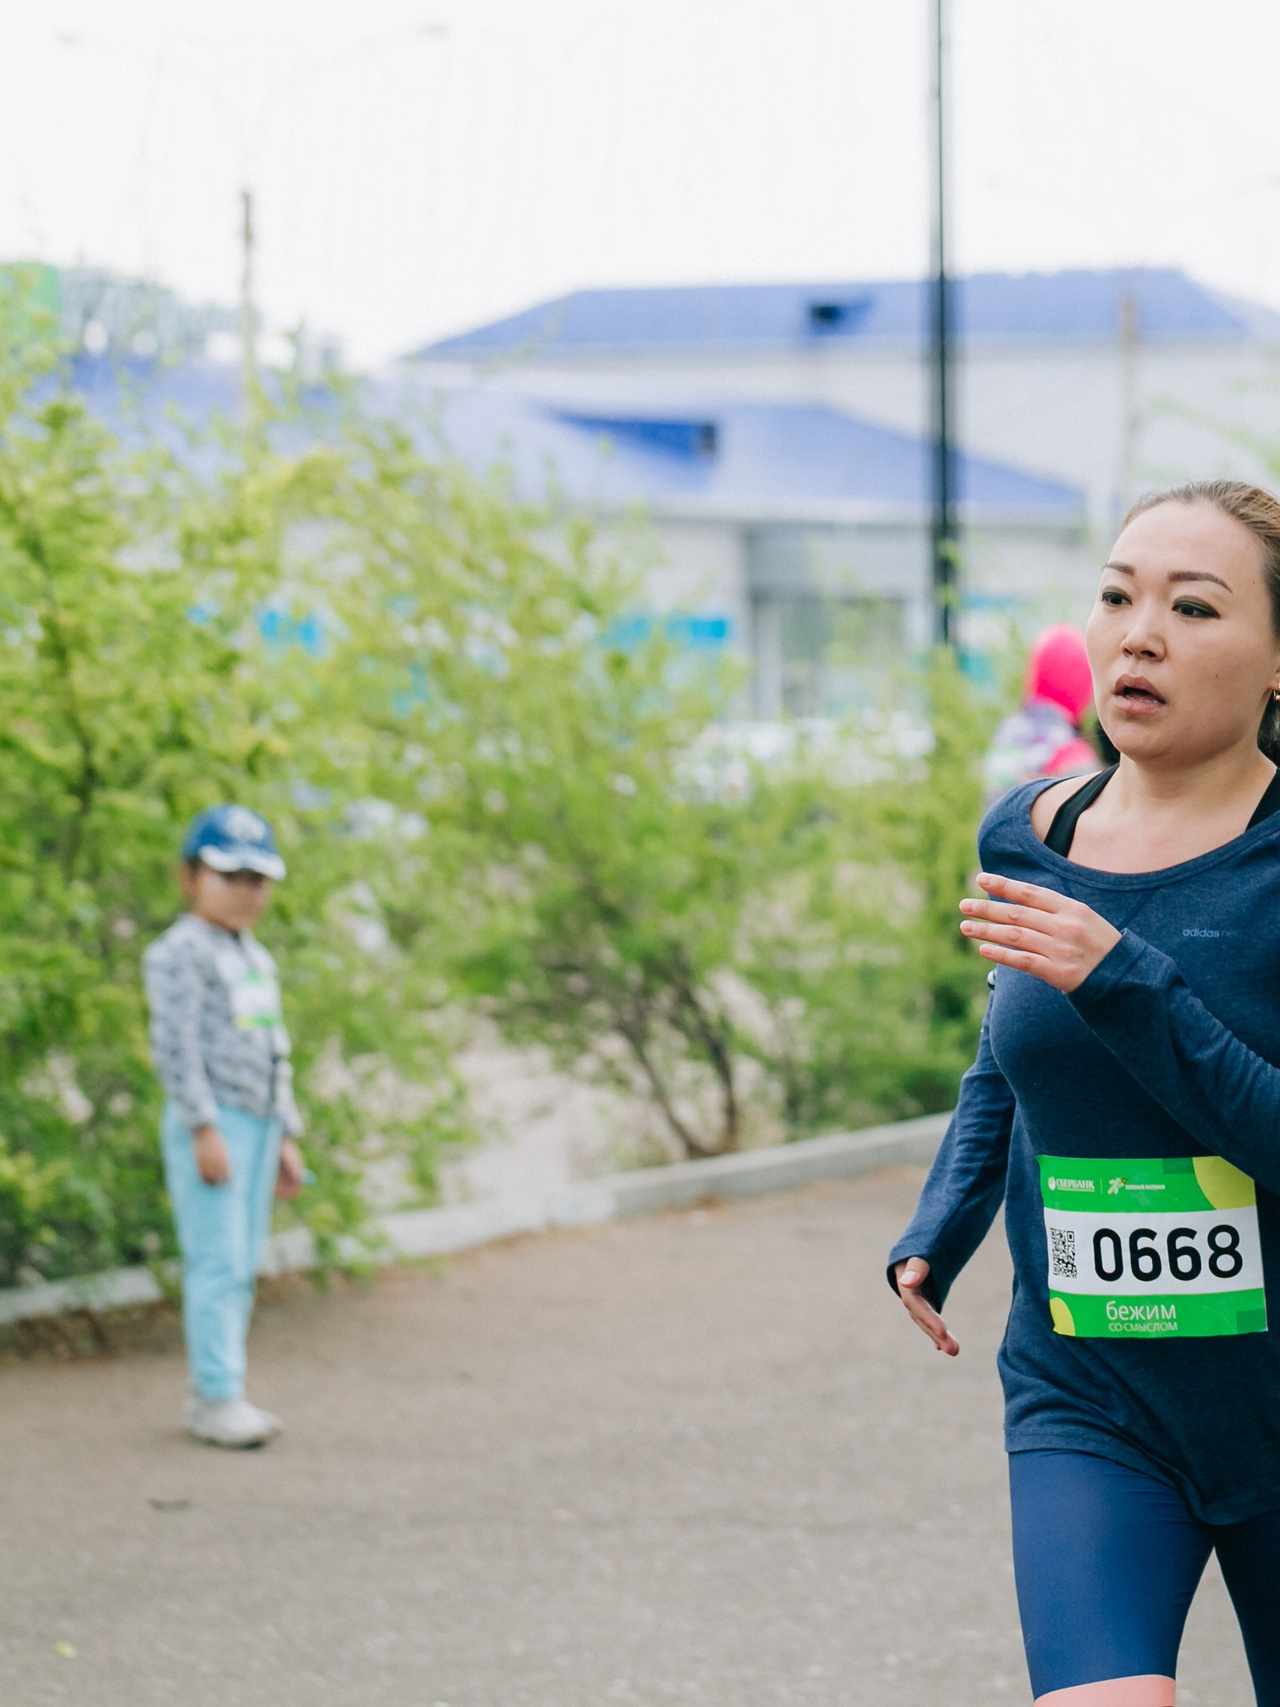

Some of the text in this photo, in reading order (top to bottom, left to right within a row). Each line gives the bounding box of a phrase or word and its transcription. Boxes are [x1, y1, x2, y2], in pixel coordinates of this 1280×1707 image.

[1182, 927, 1220, 938] adidas
[1056, 1178, 1095, 1189] СБЕРБАНК
[1092, 1224, 1244, 1282] 0668
[1106, 1300, 1177, 1321] бежим
